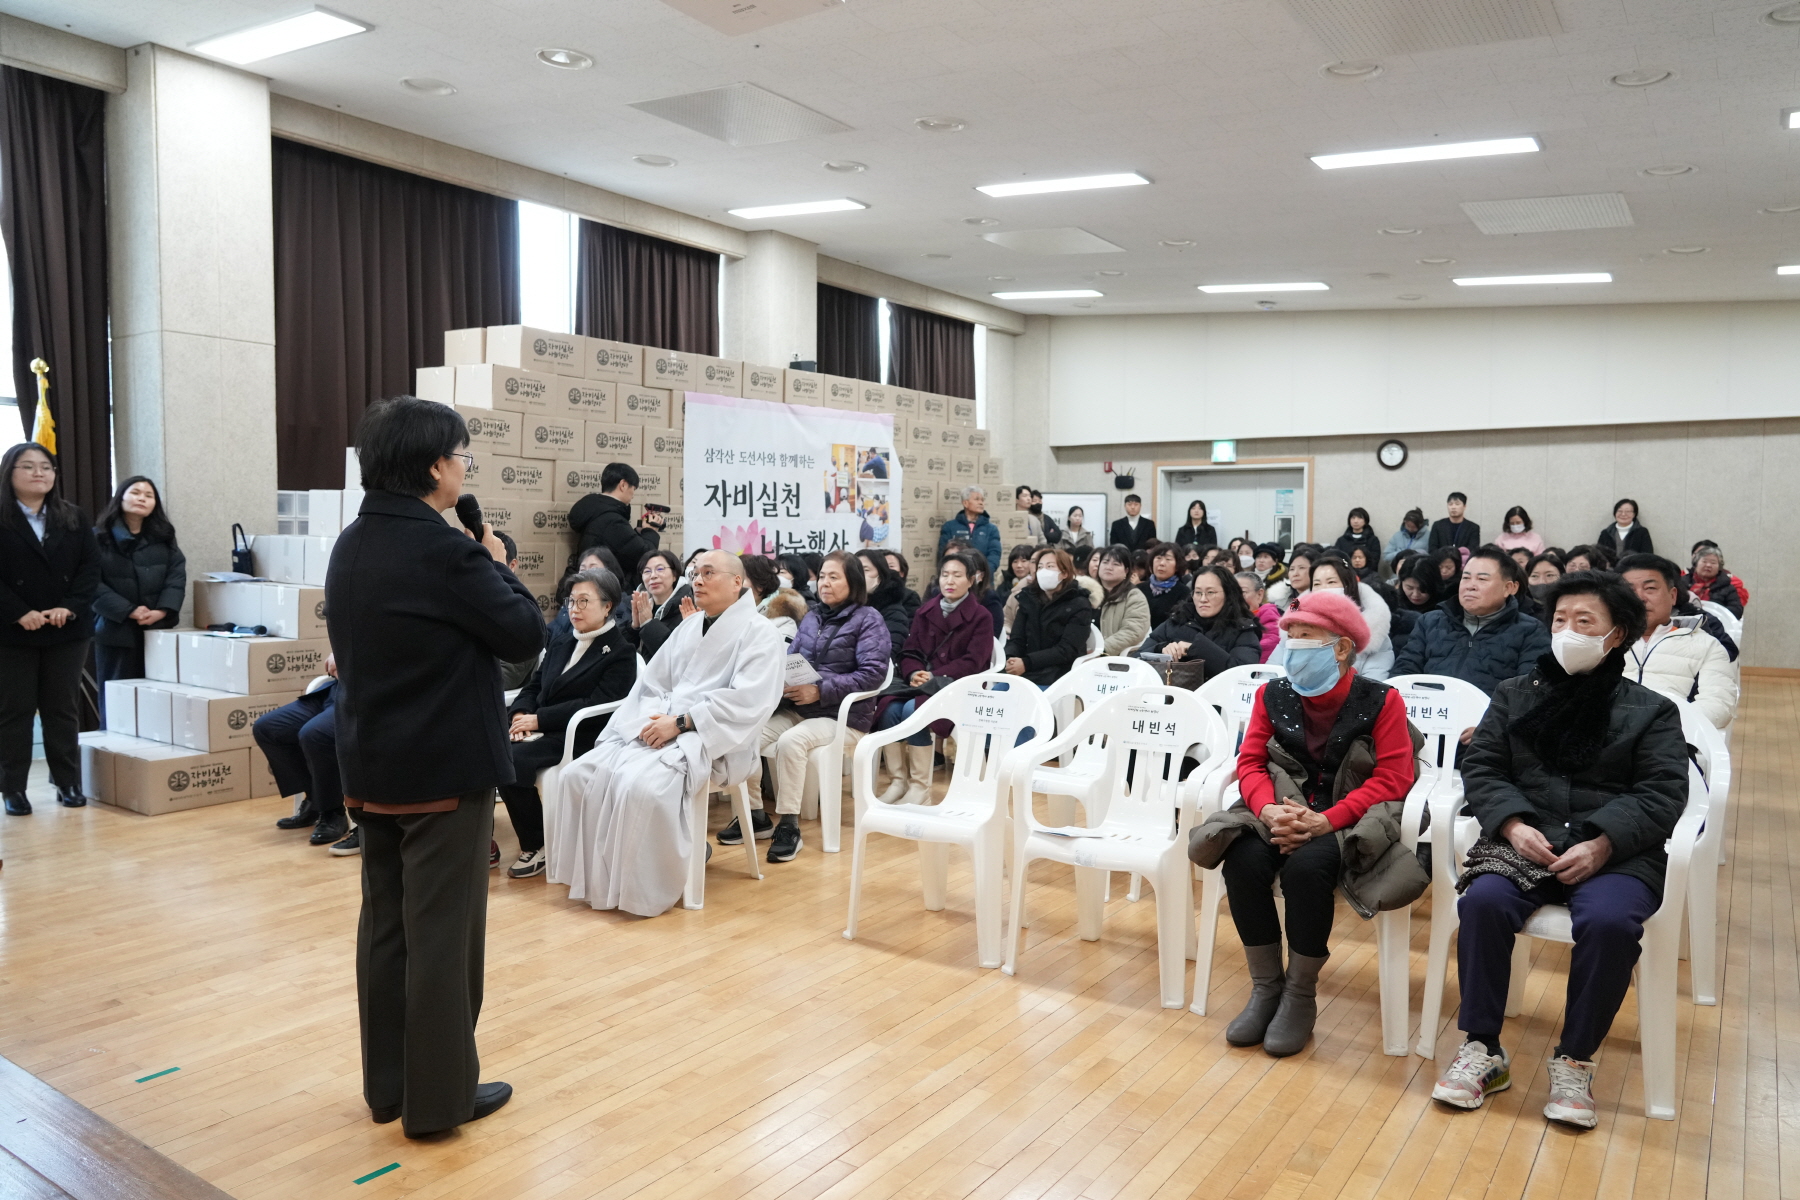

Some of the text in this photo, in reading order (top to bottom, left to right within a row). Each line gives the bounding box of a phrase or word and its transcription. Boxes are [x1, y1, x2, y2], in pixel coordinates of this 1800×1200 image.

[704, 448, 815, 469] 삼각산 도선사와 함께하는
[704, 479, 801, 518] 자비실천
[191, 765, 231, 778] 자비실천
